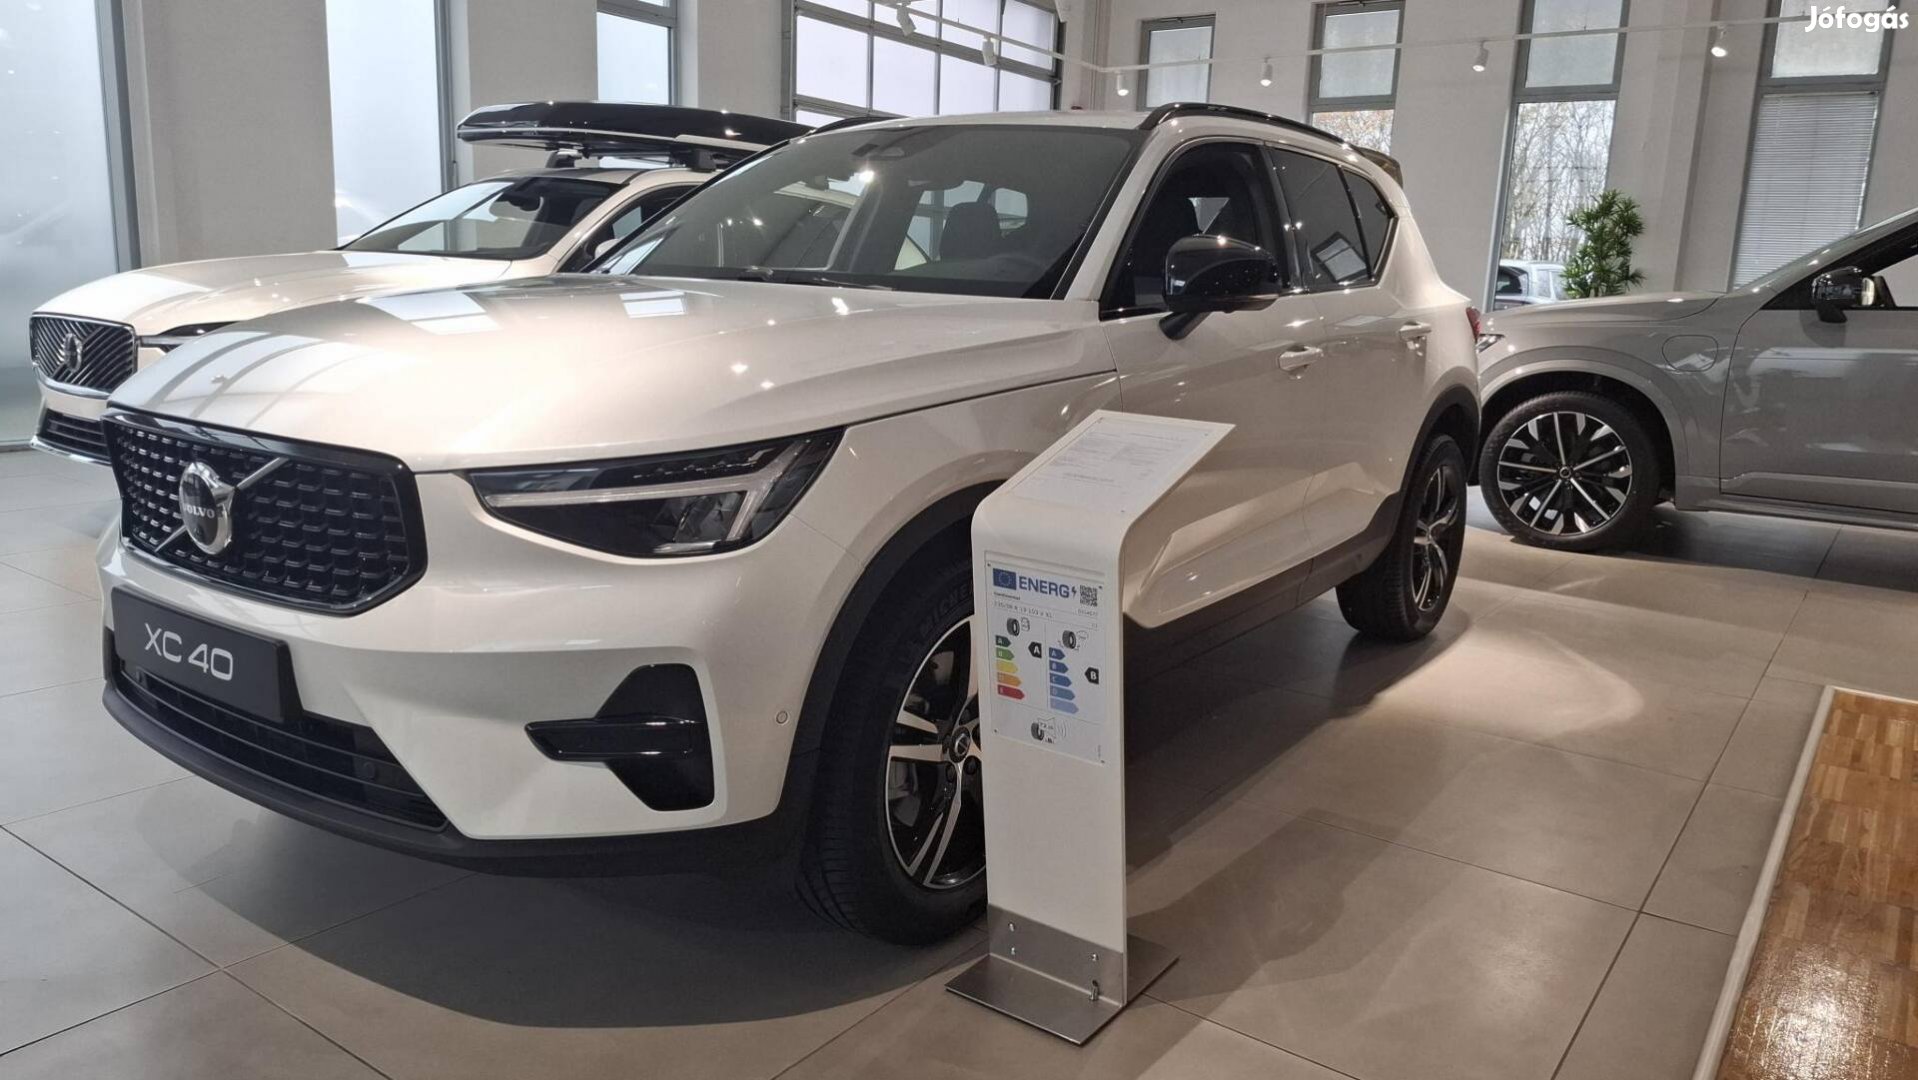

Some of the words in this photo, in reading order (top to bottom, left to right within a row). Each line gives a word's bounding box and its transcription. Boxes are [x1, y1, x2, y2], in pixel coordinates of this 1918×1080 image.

[1019, 575, 1070, 599] ENERG
[144, 622, 182, 663] XC
[188, 643, 234, 681] 40
[1033, 645, 1040, 655] A
[1090, 671, 1097, 680] B
